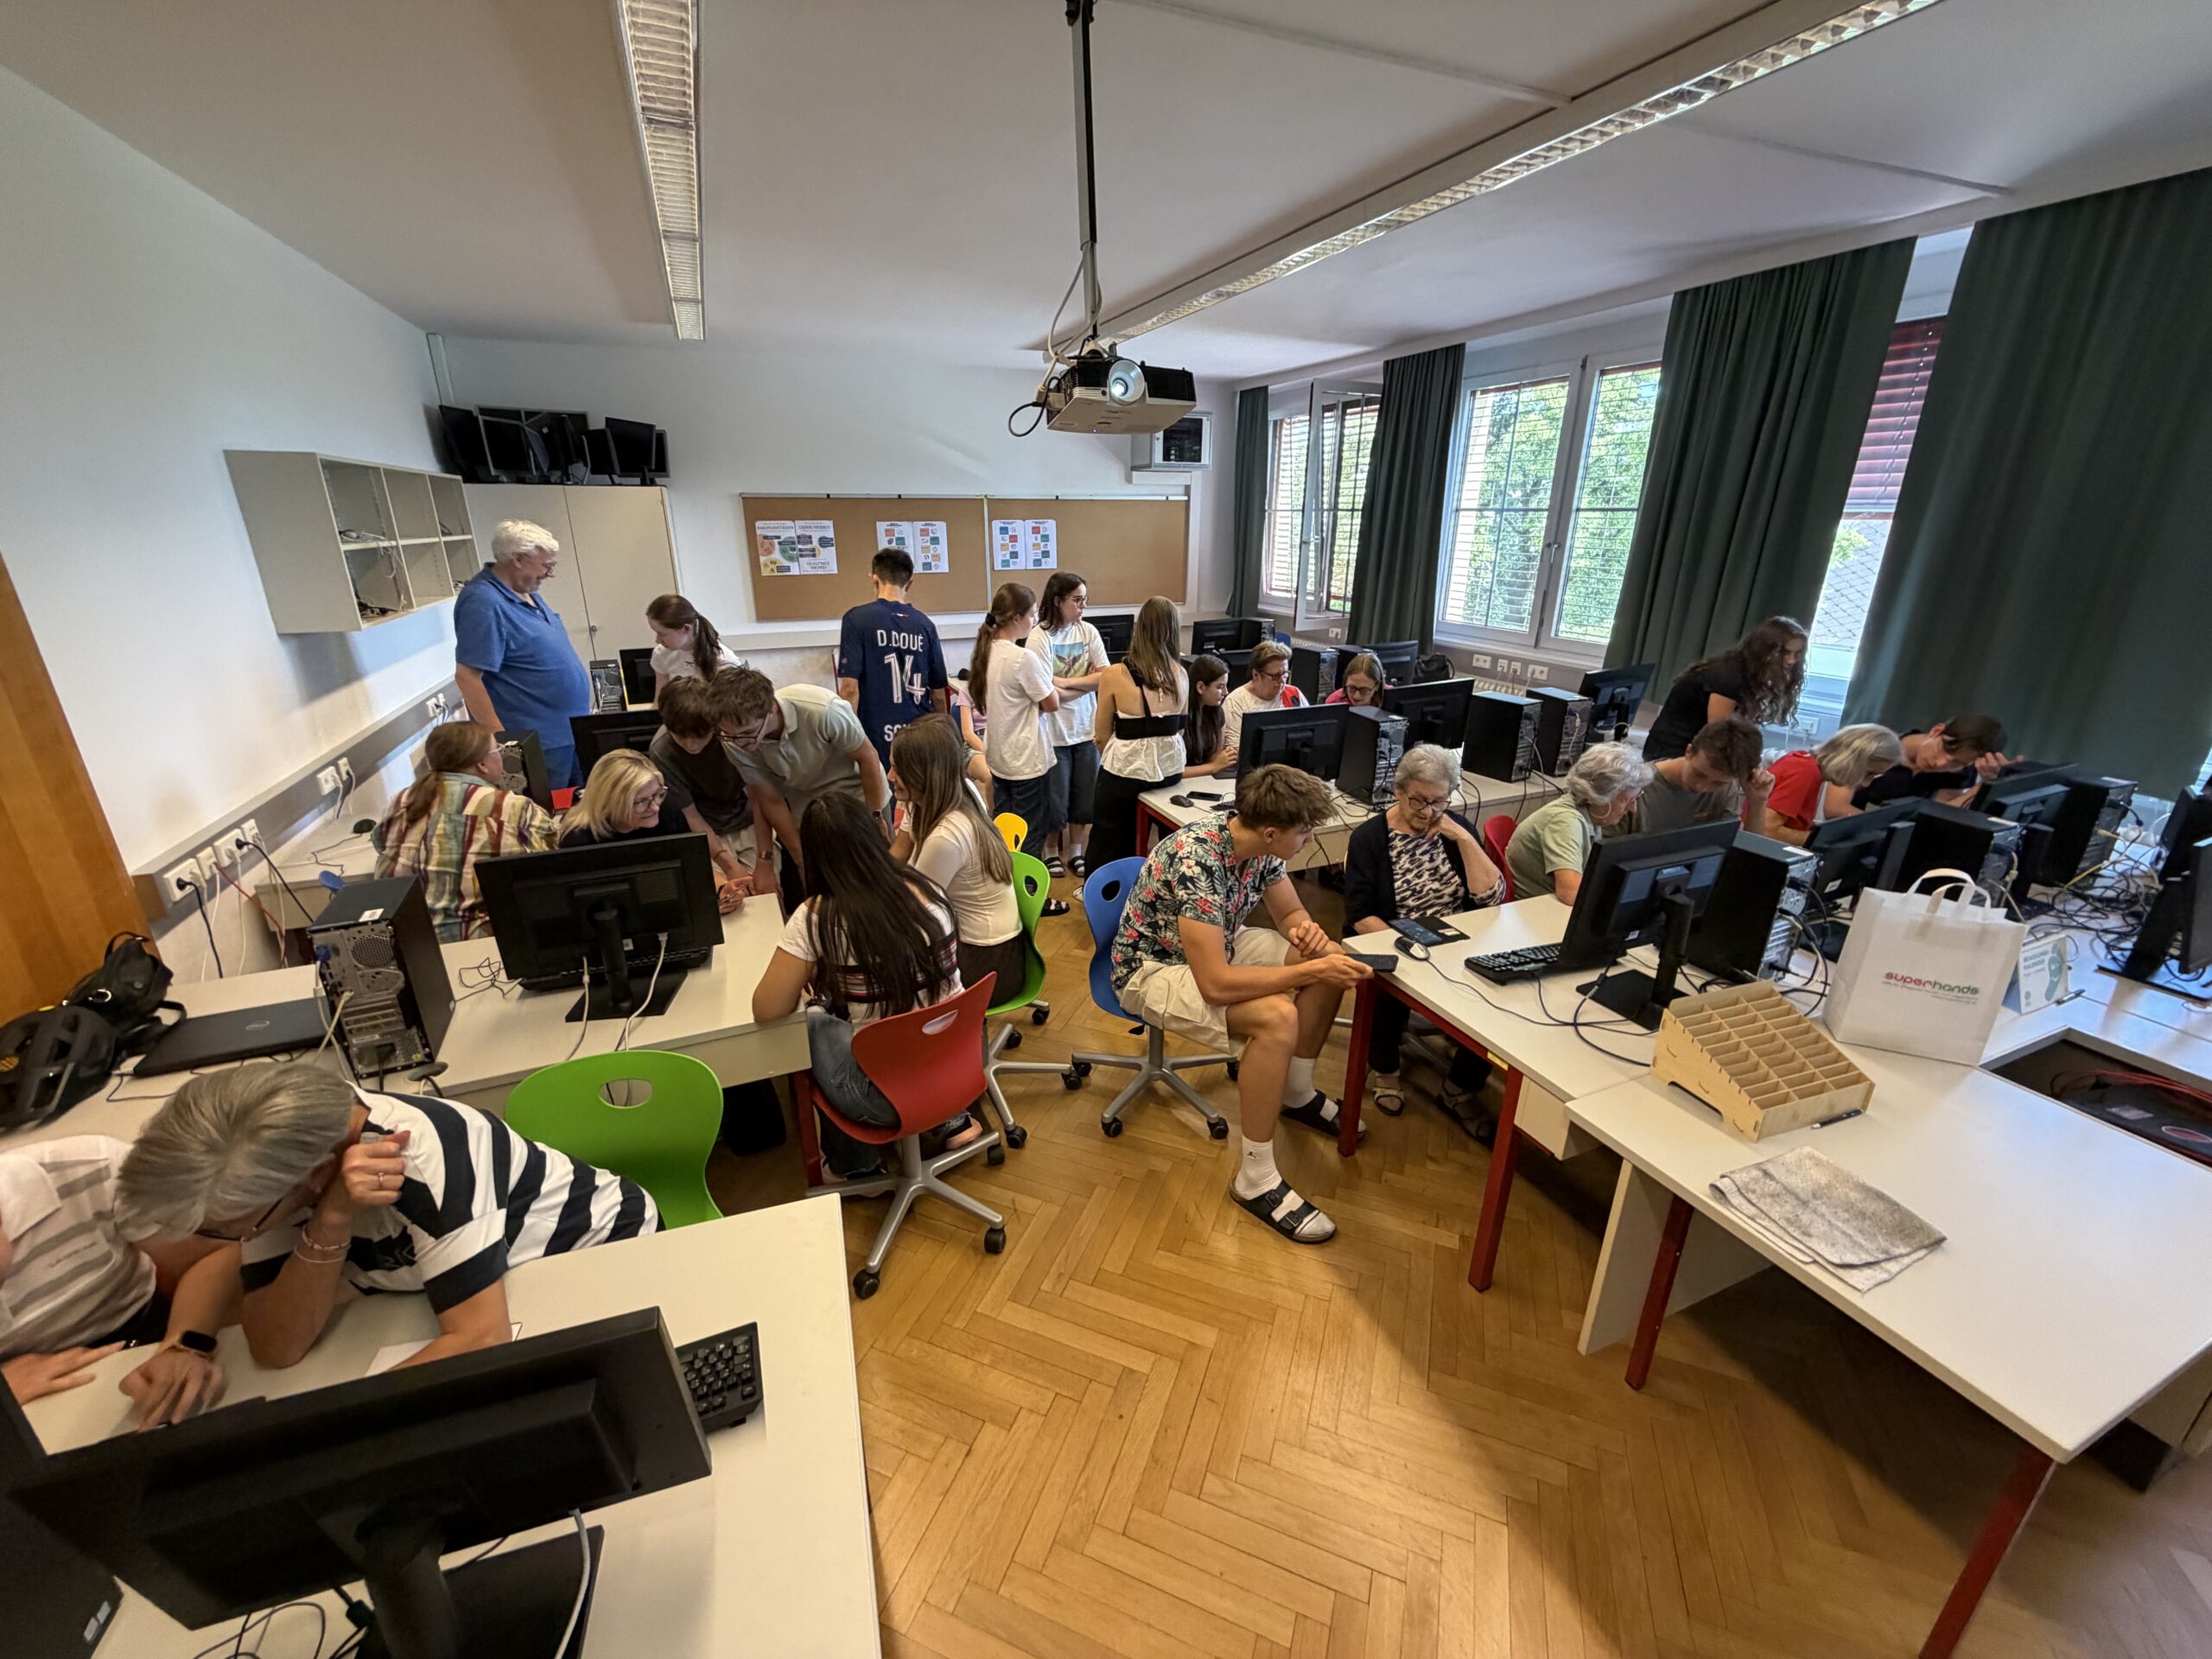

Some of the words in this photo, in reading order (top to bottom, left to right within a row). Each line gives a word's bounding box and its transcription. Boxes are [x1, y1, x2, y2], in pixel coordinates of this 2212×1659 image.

[876, 629, 924, 652] D.DOUÉ
[884, 652, 926, 705] 14
[1884, 971, 1980, 995] superhands
